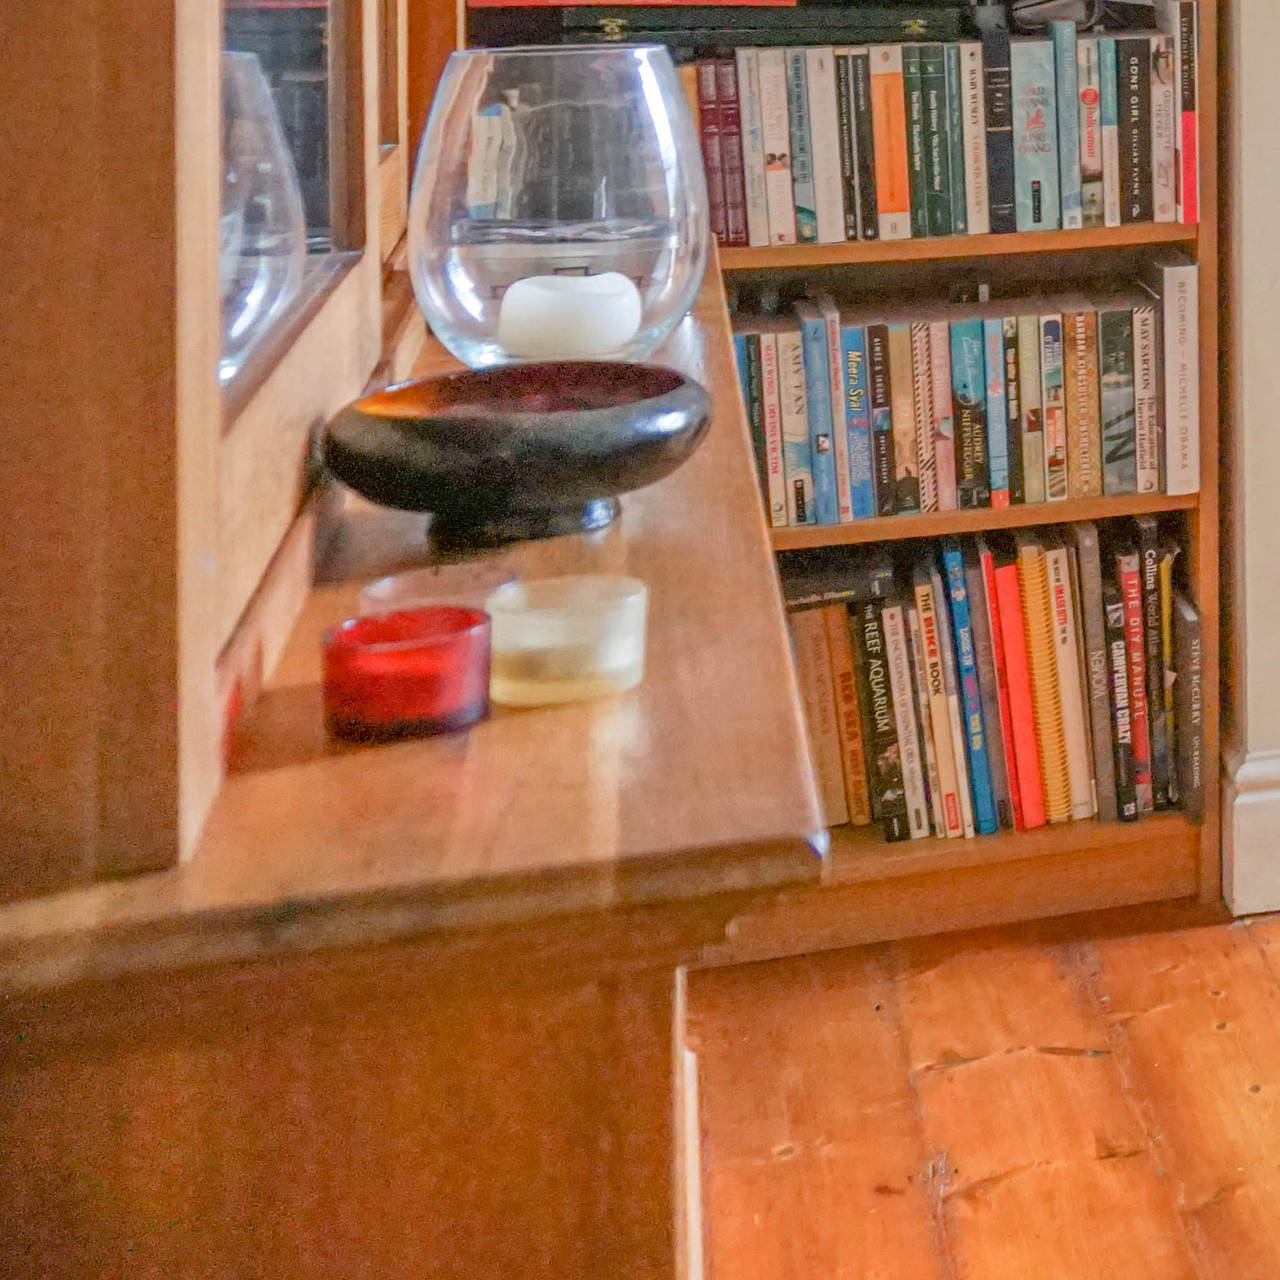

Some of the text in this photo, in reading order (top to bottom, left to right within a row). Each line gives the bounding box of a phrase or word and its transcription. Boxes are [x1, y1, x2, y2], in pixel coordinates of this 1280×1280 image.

[1130, 56, 1139, 91] GONE
[1130, 96, 1139, 123] GIRL
[1075, 316, 1087, 357] BARBARA
[1141, 317, 1151, 390] MAY SARTON
[790, 343, 805, 415] AMY TAN
[847, 350, 862, 385] Meera
[1077, 360, 1089, 413] KINGSOLVER
[1177, 280, 1189, 470] BECOMING MICHELLE OBAMA
[1147, 395, 1156, 412] The
[961, 409, 974, 481] NIFFENEGGER
[972, 423, 984, 464] AUDREY
[1145, 549, 1157, 590] Collins
[864, 622, 881, 654] REEF
[920, 592, 942, 697] THE BIKE BOOK
[1127, 578, 1145, 720] THE DIY MANUAL
[1191, 638, 1200, 671] STEVE
[868, 659, 890, 733] AQUARIUM
[1111, 640, 1131, 744] CAMPERVAN CRAZY
